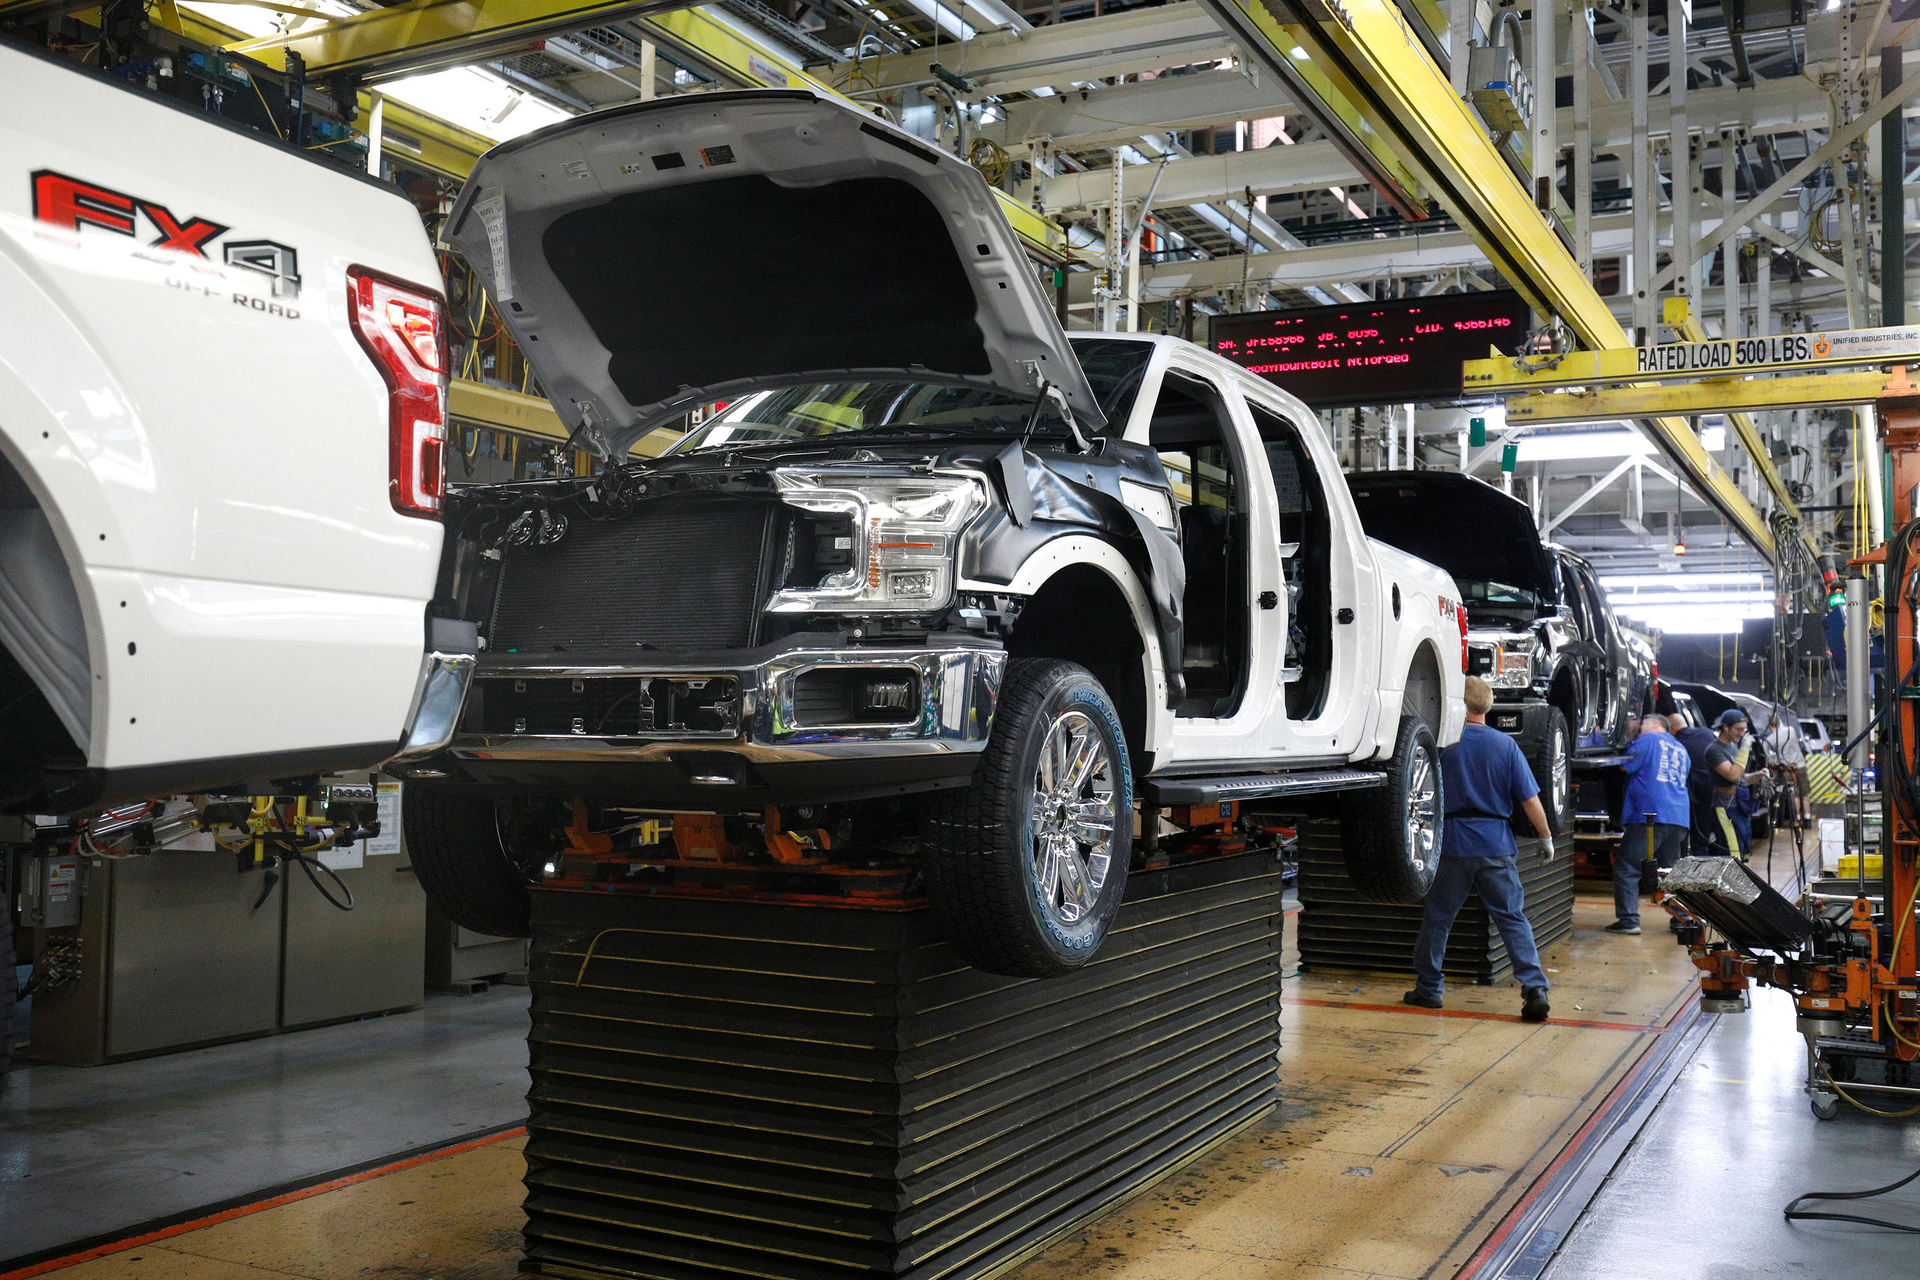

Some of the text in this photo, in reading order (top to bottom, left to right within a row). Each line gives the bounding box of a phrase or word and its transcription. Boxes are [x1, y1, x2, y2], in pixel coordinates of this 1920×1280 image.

[232, 293, 301, 319] ROAD
[1833, 336, 1860, 345] UNIFIED
[1905, 332, 1919, 340] INC.
[1637, 336, 1812, 372] RATED LOAD 500 LBS.
[1438, 595, 1456, 618] FX4
[1074, 689, 1133, 809] WRANGLER
